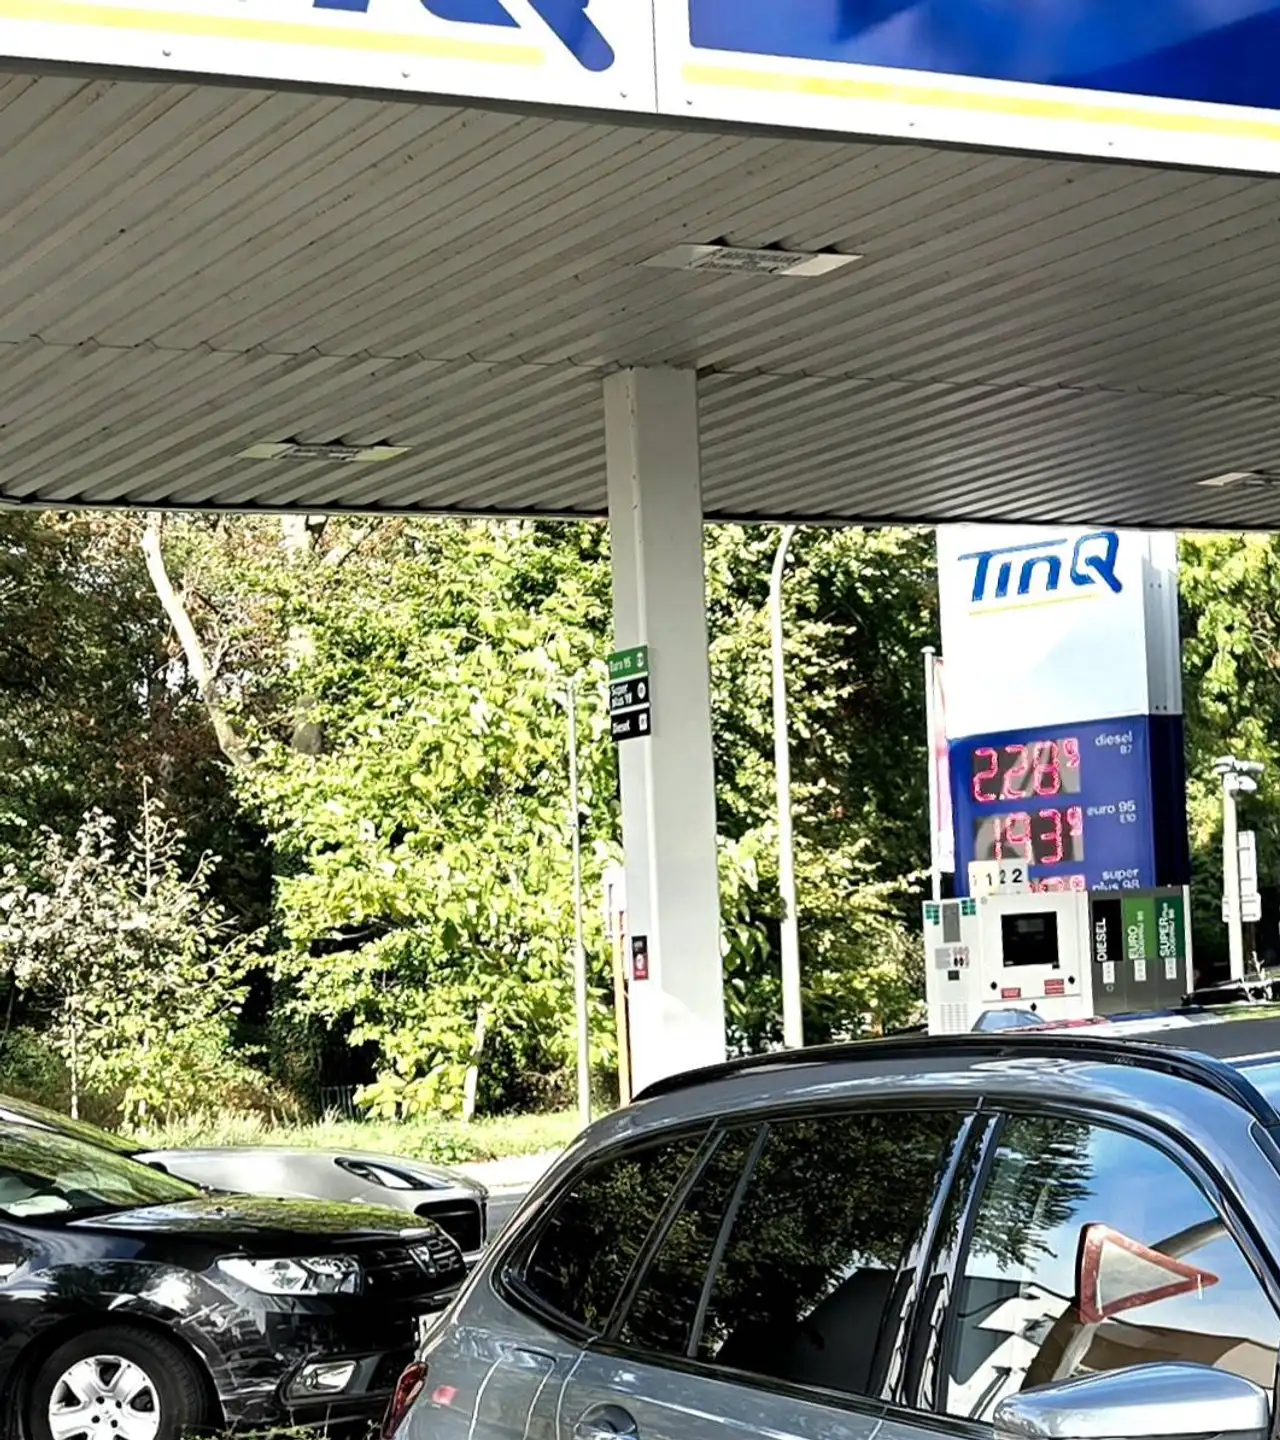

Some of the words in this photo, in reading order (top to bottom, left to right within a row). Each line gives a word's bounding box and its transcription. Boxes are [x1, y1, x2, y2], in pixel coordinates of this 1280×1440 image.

[957, 531, 1123, 602] TinQ
[1095, 731, 1133, 746] diesel
[1087, 806, 1116, 816] euro
[1118, 800, 1135, 812] 95
[1102, 868, 1139, 880] super
[1096, 917, 1108, 962] DIESEL
[1127, 925, 1138, 960] EURO
[1158, 917, 1170, 957] SUPER
